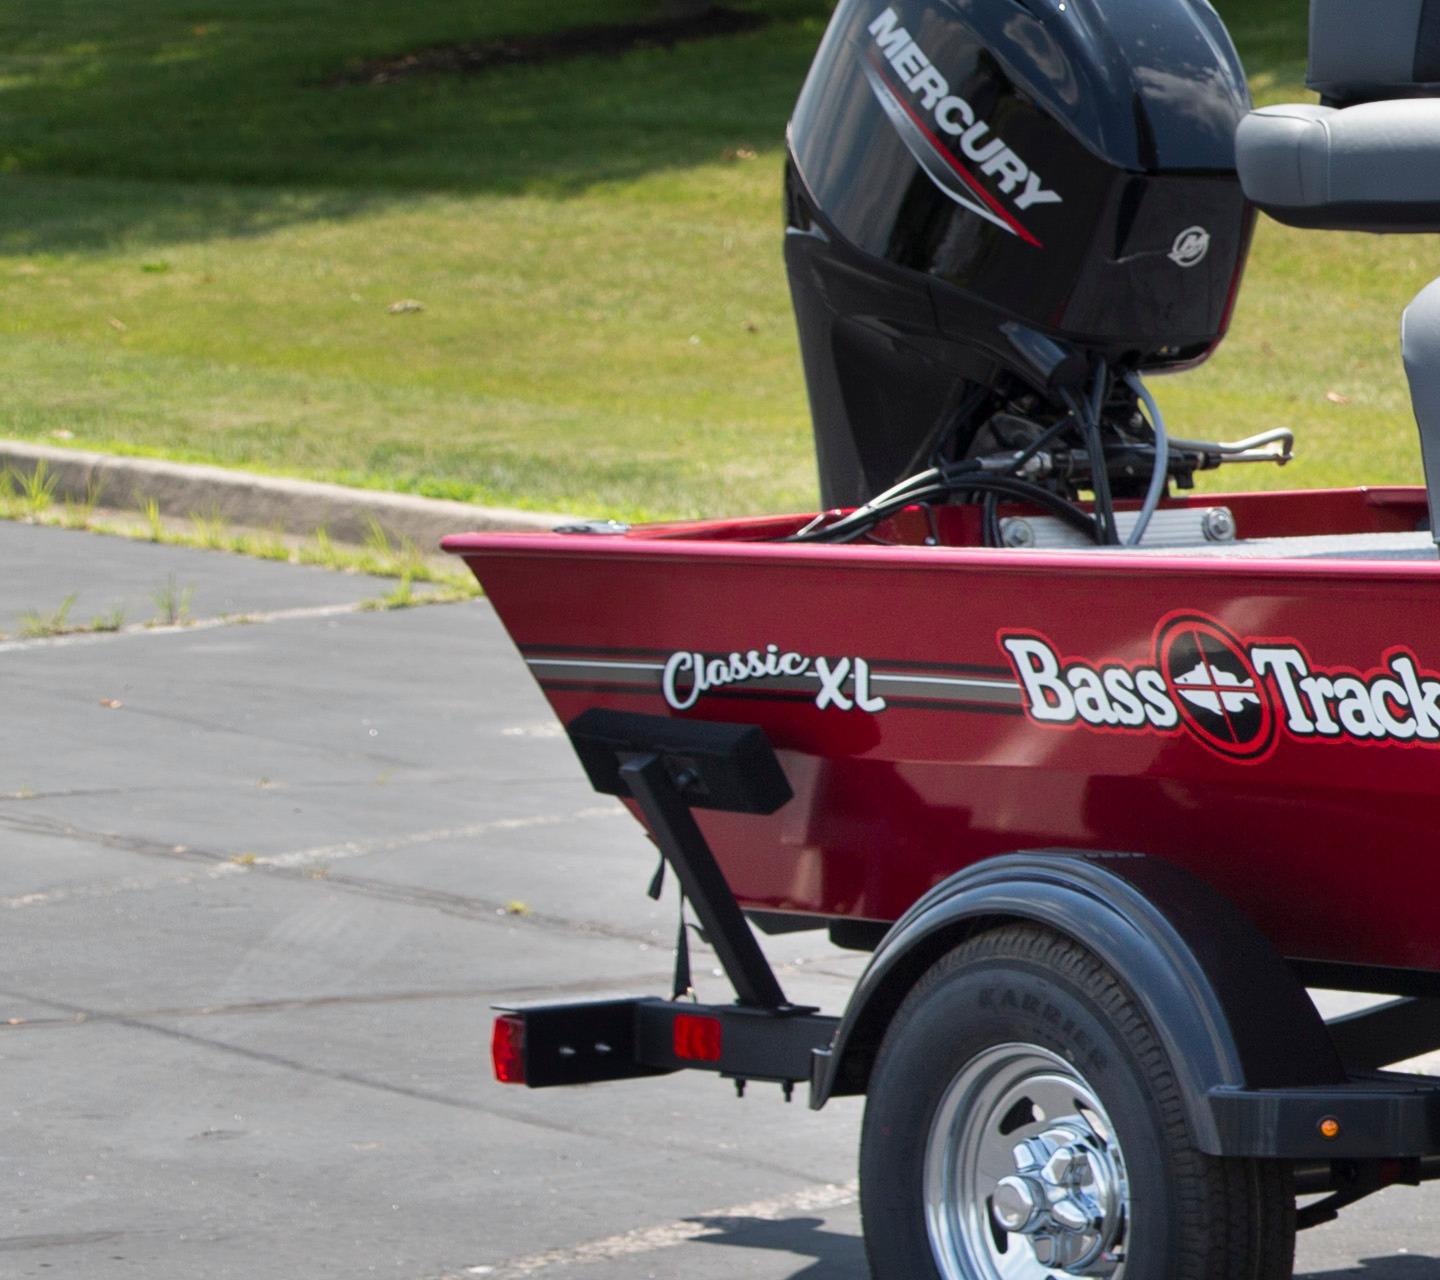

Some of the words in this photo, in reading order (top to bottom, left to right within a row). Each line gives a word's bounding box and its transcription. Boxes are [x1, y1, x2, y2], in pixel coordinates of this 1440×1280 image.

[868, 7, 1063, 210] MERCURY
[662, 643, 811, 710] Classic
[815, 656, 887, 712] XL
[1005, 637, 1179, 728] Bass
